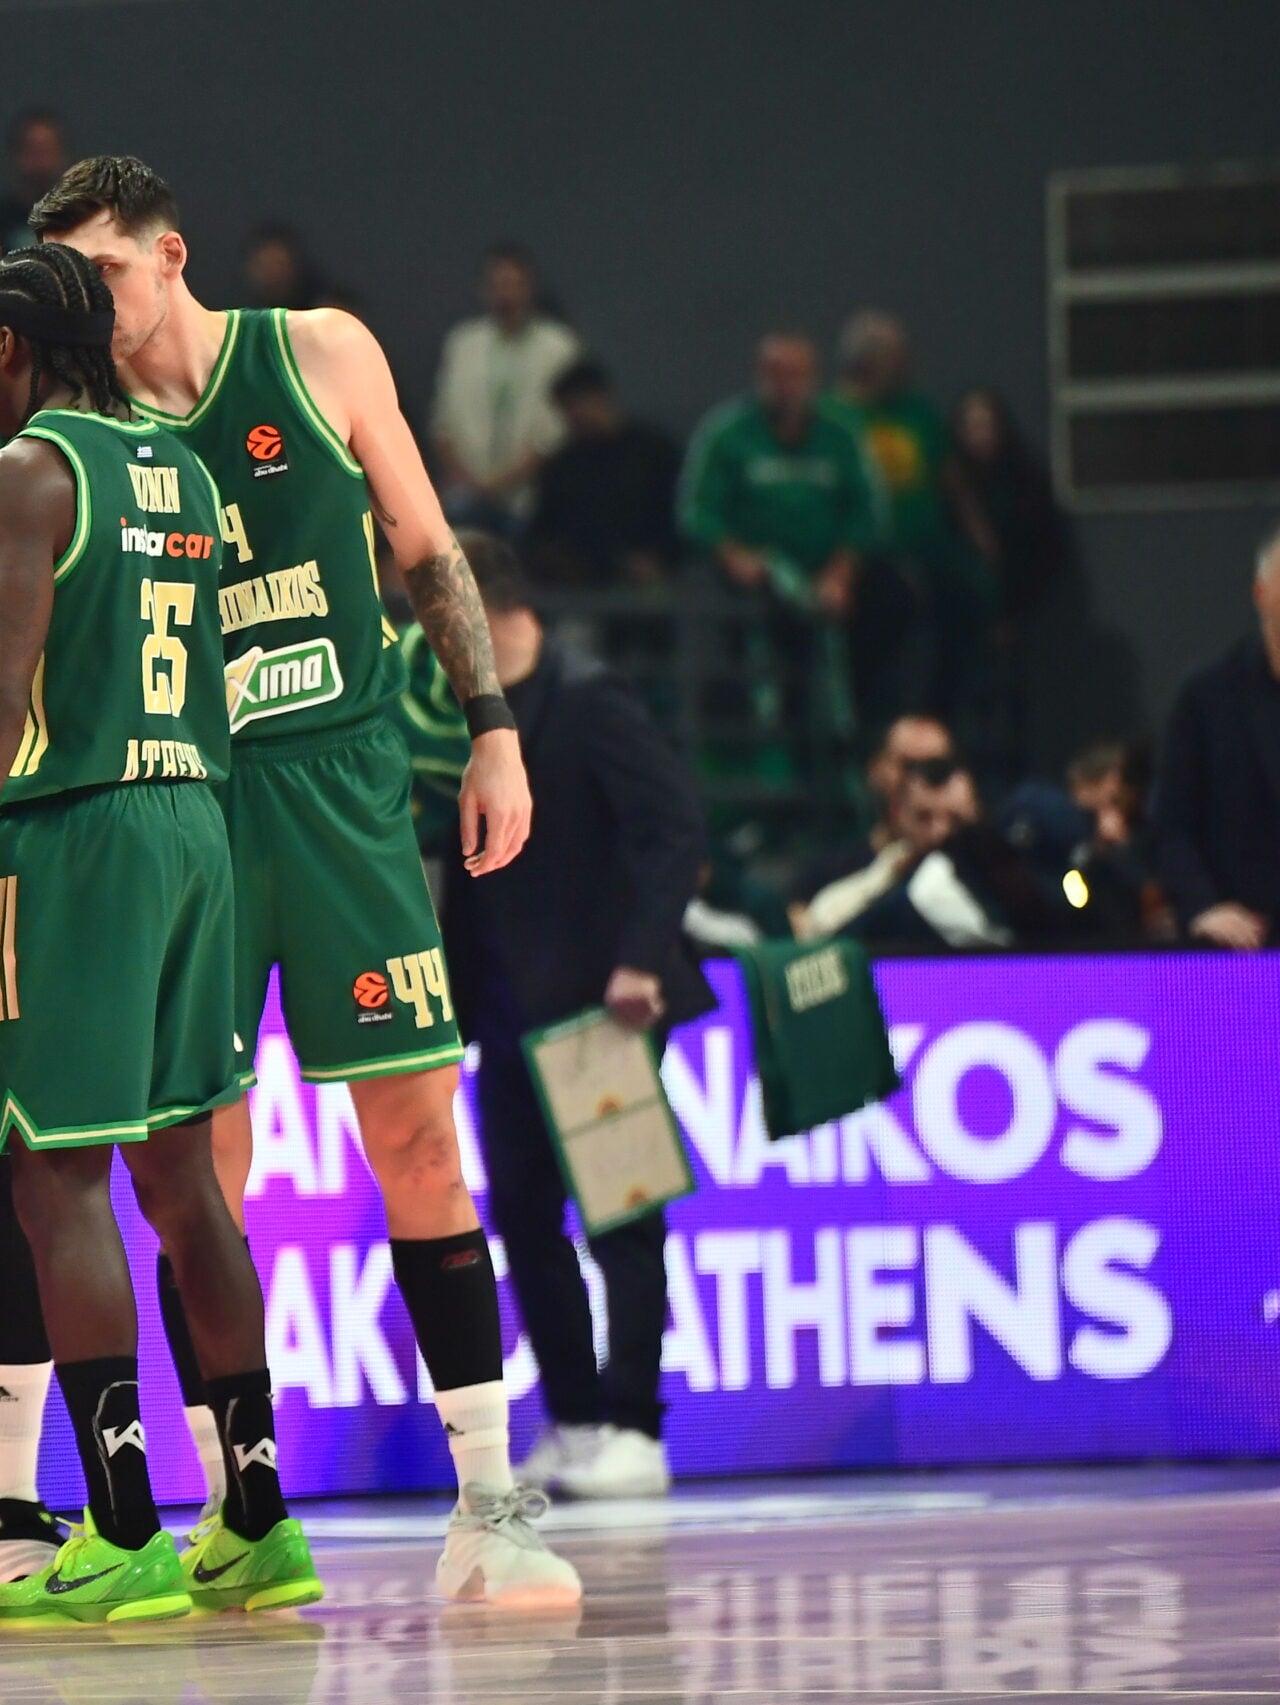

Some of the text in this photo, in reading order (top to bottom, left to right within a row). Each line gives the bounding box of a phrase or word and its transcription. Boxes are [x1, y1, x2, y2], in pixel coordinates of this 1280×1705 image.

[120, 516, 214, 560] insacar
[140, 578, 196, 718] 25
[386, 947, 453, 1029] 44
[660, 1216, 1174, 1392] ATHENS
